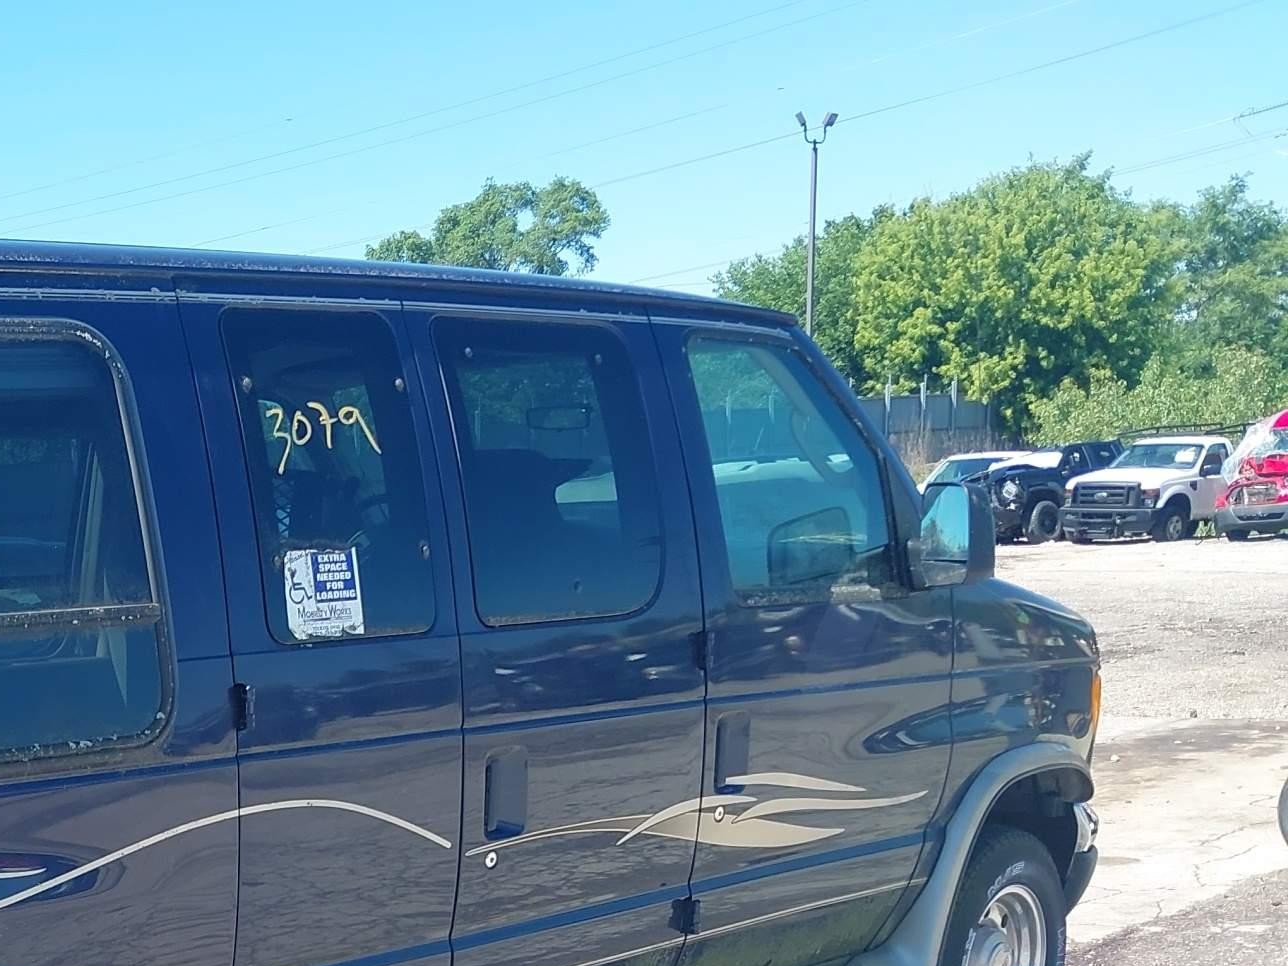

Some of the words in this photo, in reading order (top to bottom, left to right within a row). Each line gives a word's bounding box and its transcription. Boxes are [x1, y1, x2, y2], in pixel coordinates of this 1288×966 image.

[265, 401, 382, 476] 3079
[317, 553, 347, 563] EXTRA
[318, 562, 348, 572] SPACE
[316, 571, 352, 582] NEEDED
[326, 581, 345, 590] FOR
[316, 589, 356, 601] LOADING
